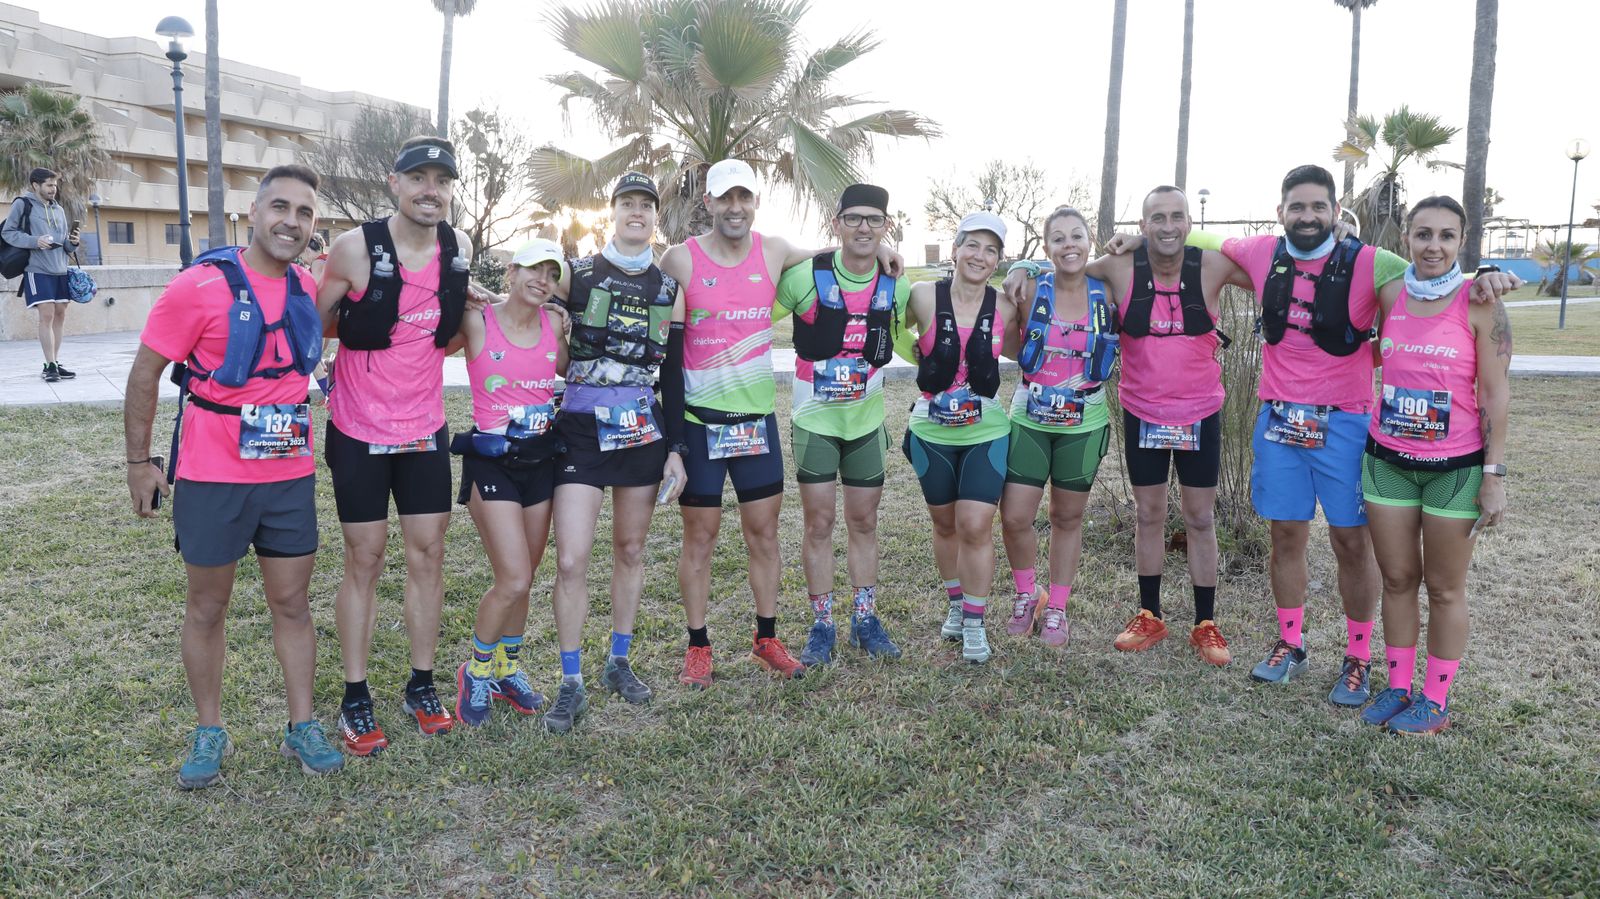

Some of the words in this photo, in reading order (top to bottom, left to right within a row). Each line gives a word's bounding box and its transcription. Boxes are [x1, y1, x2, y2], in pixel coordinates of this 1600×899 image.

[716, 306, 772, 320] run&fi
[1396, 343, 1459, 359] run&fit
[834, 365, 850, 381] 13
[820, 385, 852, 393] Carbonera
[949, 398, 959, 412] 6
[1397, 396, 1428, 416] 190
[263, 413, 292, 433] 132
[528, 412, 549, 431] 125
[619, 409, 638, 428] 40
[1287, 408, 1305, 426] 94
[1385, 417, 1422, 429] Carbonera
[1424, 422, 1445, 431] 2023
[606, 431, 641, 440] Carbonera
[1146, 433, 1180, 441] Carbonera
[1273, 425, 1305, 438] Carbonera
[1304, 431, 1324, 440] 2023
[248, 439, 289, 447] Carbonera
[289, 437, 306, 446] 2023
